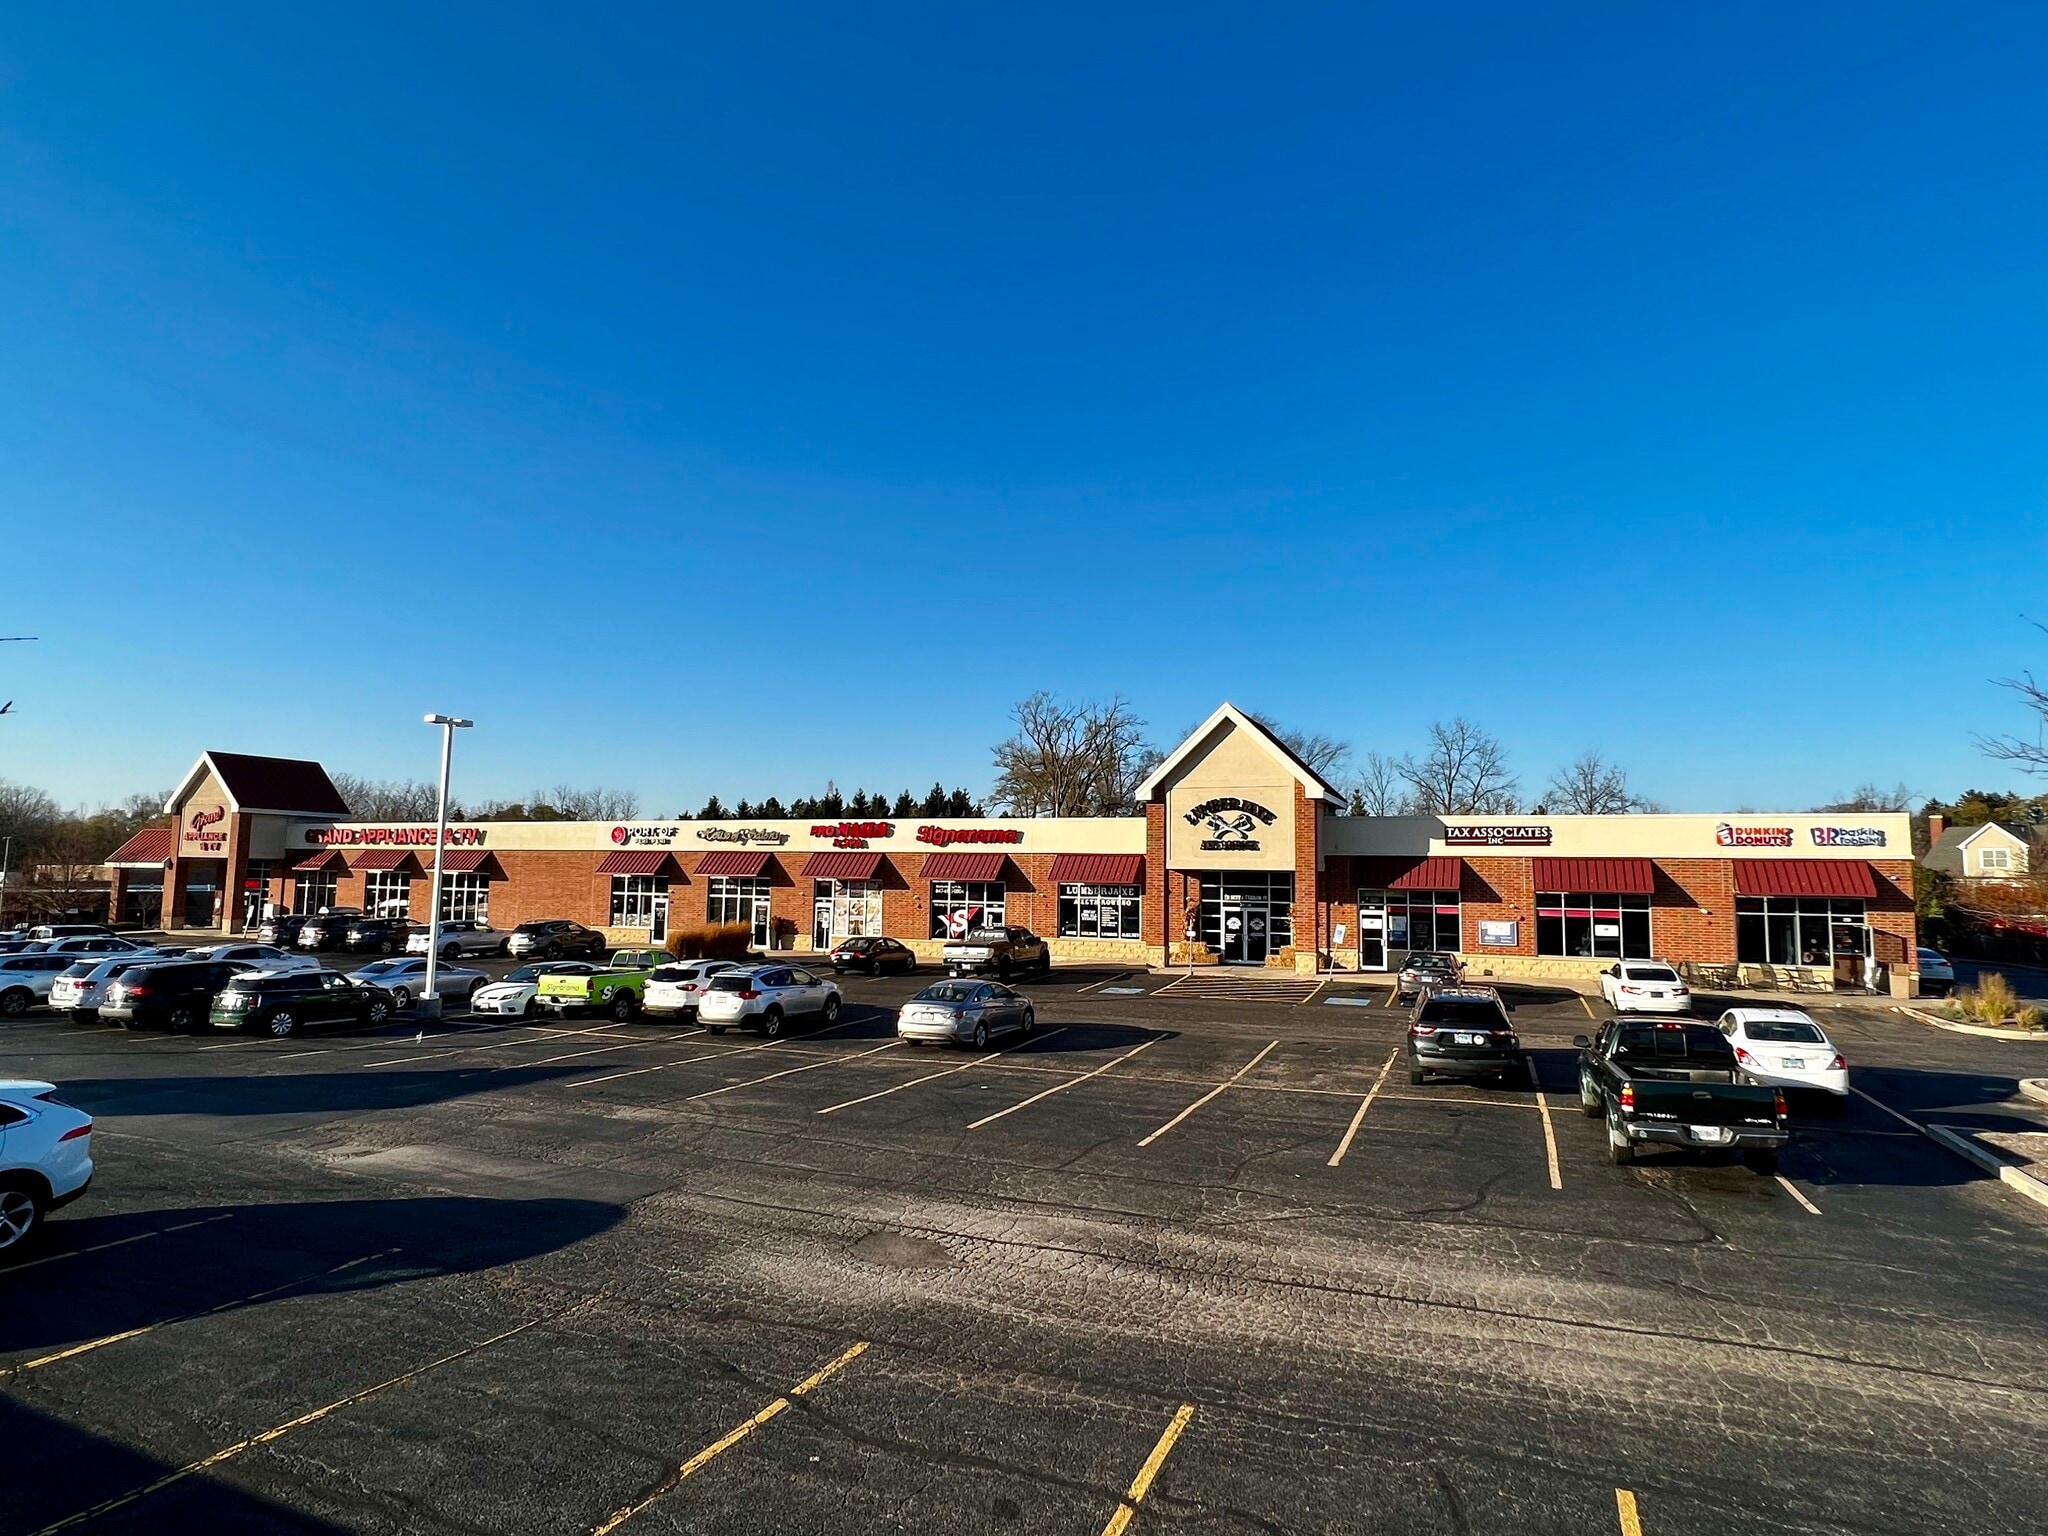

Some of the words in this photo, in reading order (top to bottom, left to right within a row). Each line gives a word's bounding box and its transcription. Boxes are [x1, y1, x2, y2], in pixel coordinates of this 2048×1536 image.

[628, 827, 657, 837] PORT
[810, 825, 834, 837] PRO
[838, 822, 889, 838] NAILS
[1446, 827, 1470, 837] TAX
[1472, 827, 1549, 837] ASSOCIATES
[1839, 827, 1880, 837] baskin
[305, 828, 352, 844] GRAND
[359, 828, 437, 845] APPLIANCE
[459, 828, 480, 845] TV
[916, 825, 1018, 846] Signarama
[1735, 836, 1787, 845] DONUTS
[1814, 827, 1838, 844] BR
[1839, 836, 1881, 845] robbins
[1488, 837, 1504, 845] INC
[546, 983, 580, 992] Signarama
